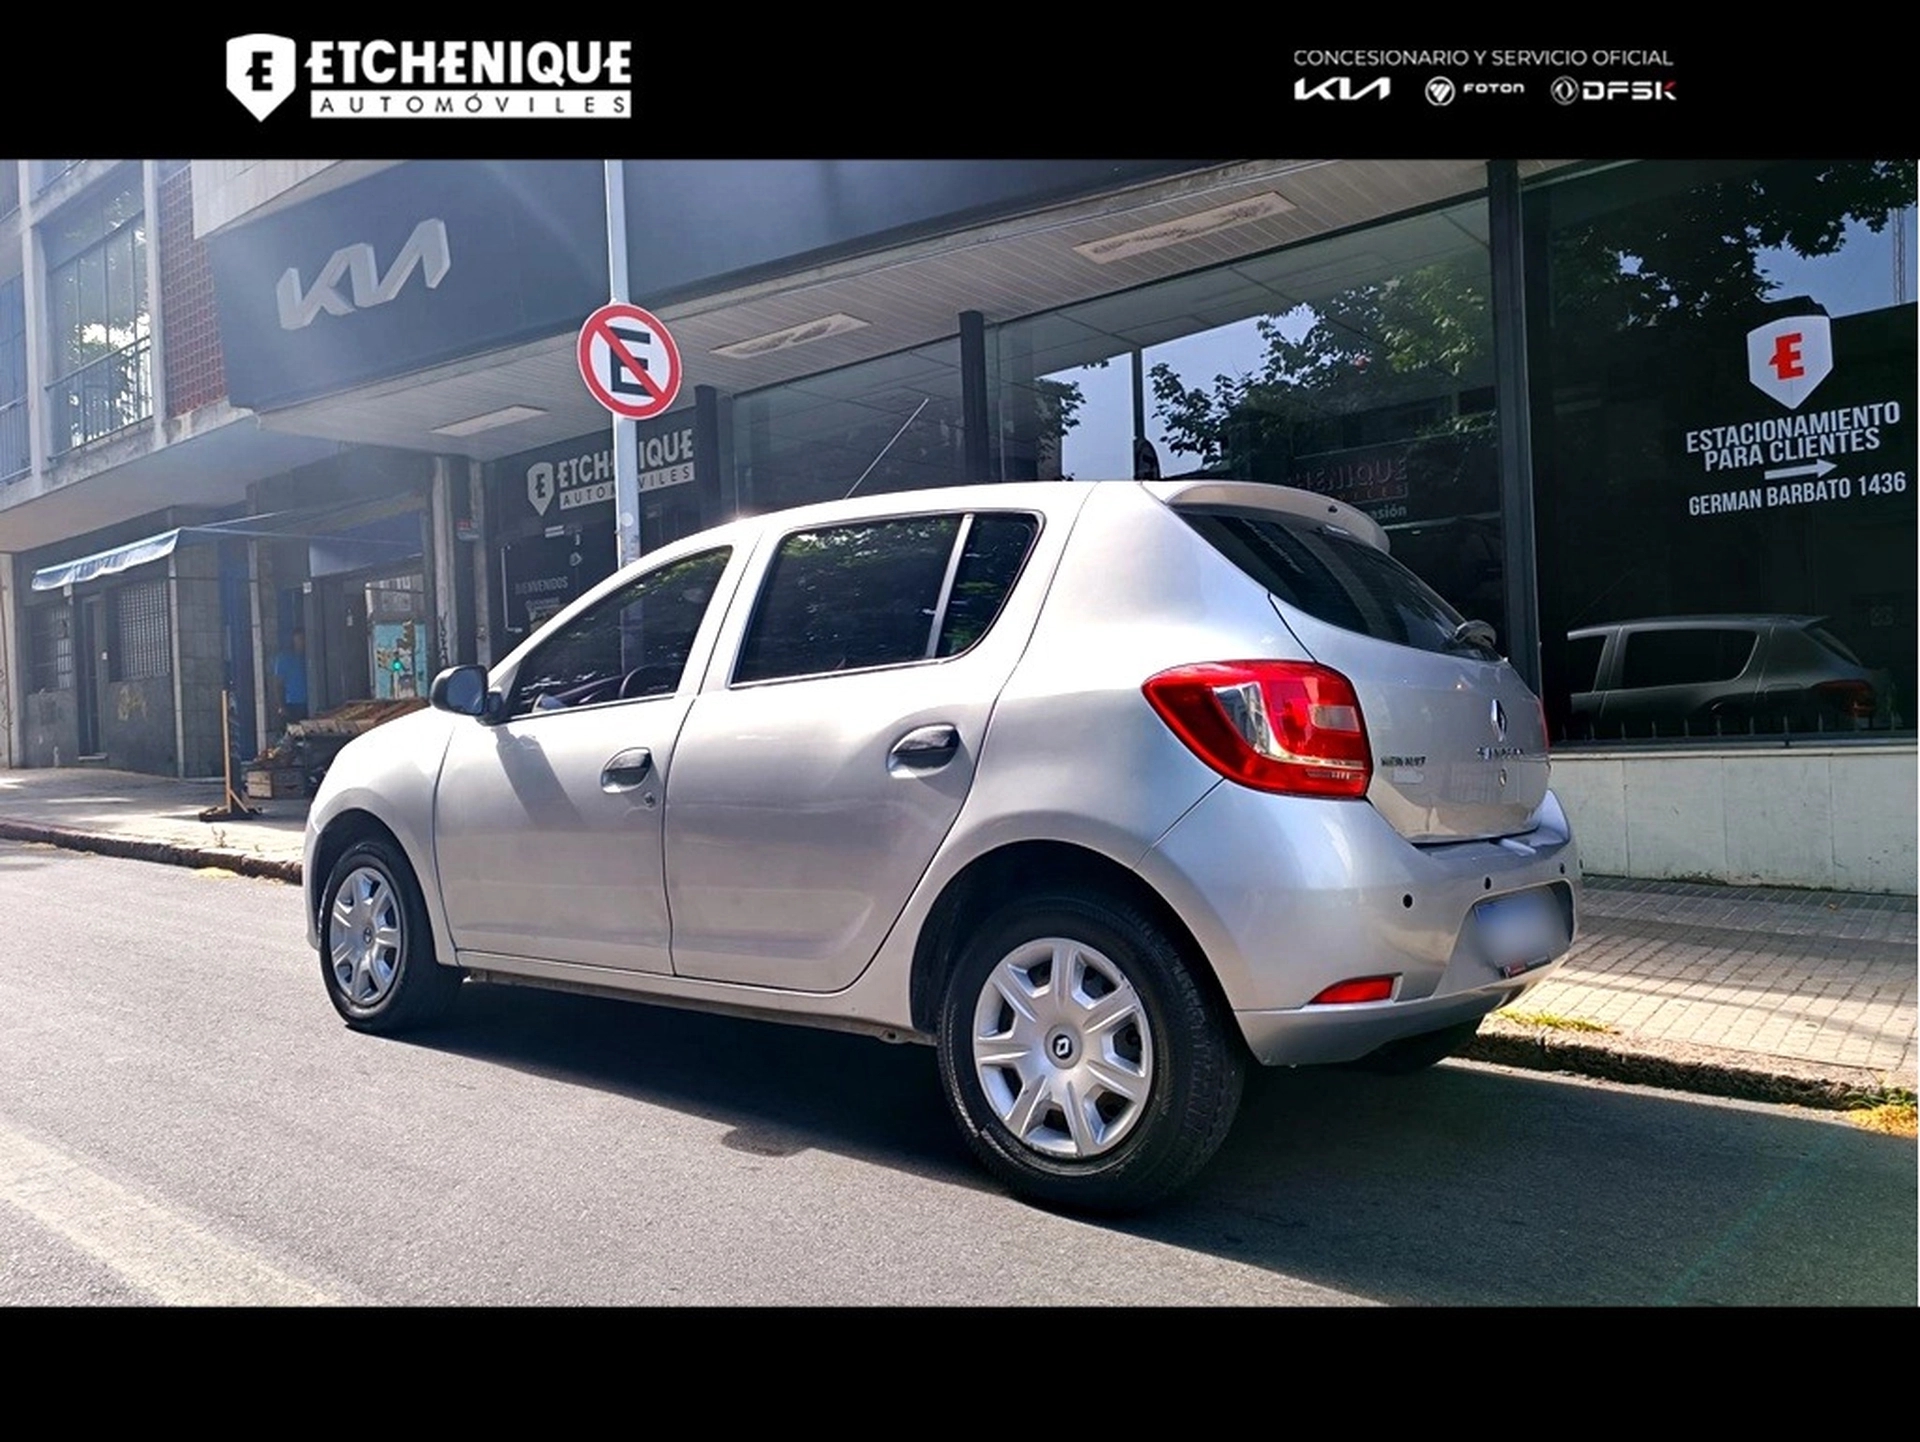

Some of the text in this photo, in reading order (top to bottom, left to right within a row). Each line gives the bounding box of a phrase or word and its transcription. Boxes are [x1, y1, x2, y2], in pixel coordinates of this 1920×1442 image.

[609, 325, 652, 399] E
[1685, 400, 1901, 454] ESTACIONAMIENTO
[1704, 427, 1881, 472] PARA CLIENTES
[557, 428, 694, 489] ETCHIQUE
[1688, 471, 1907, 516] GERMAN BARBATO 1436
